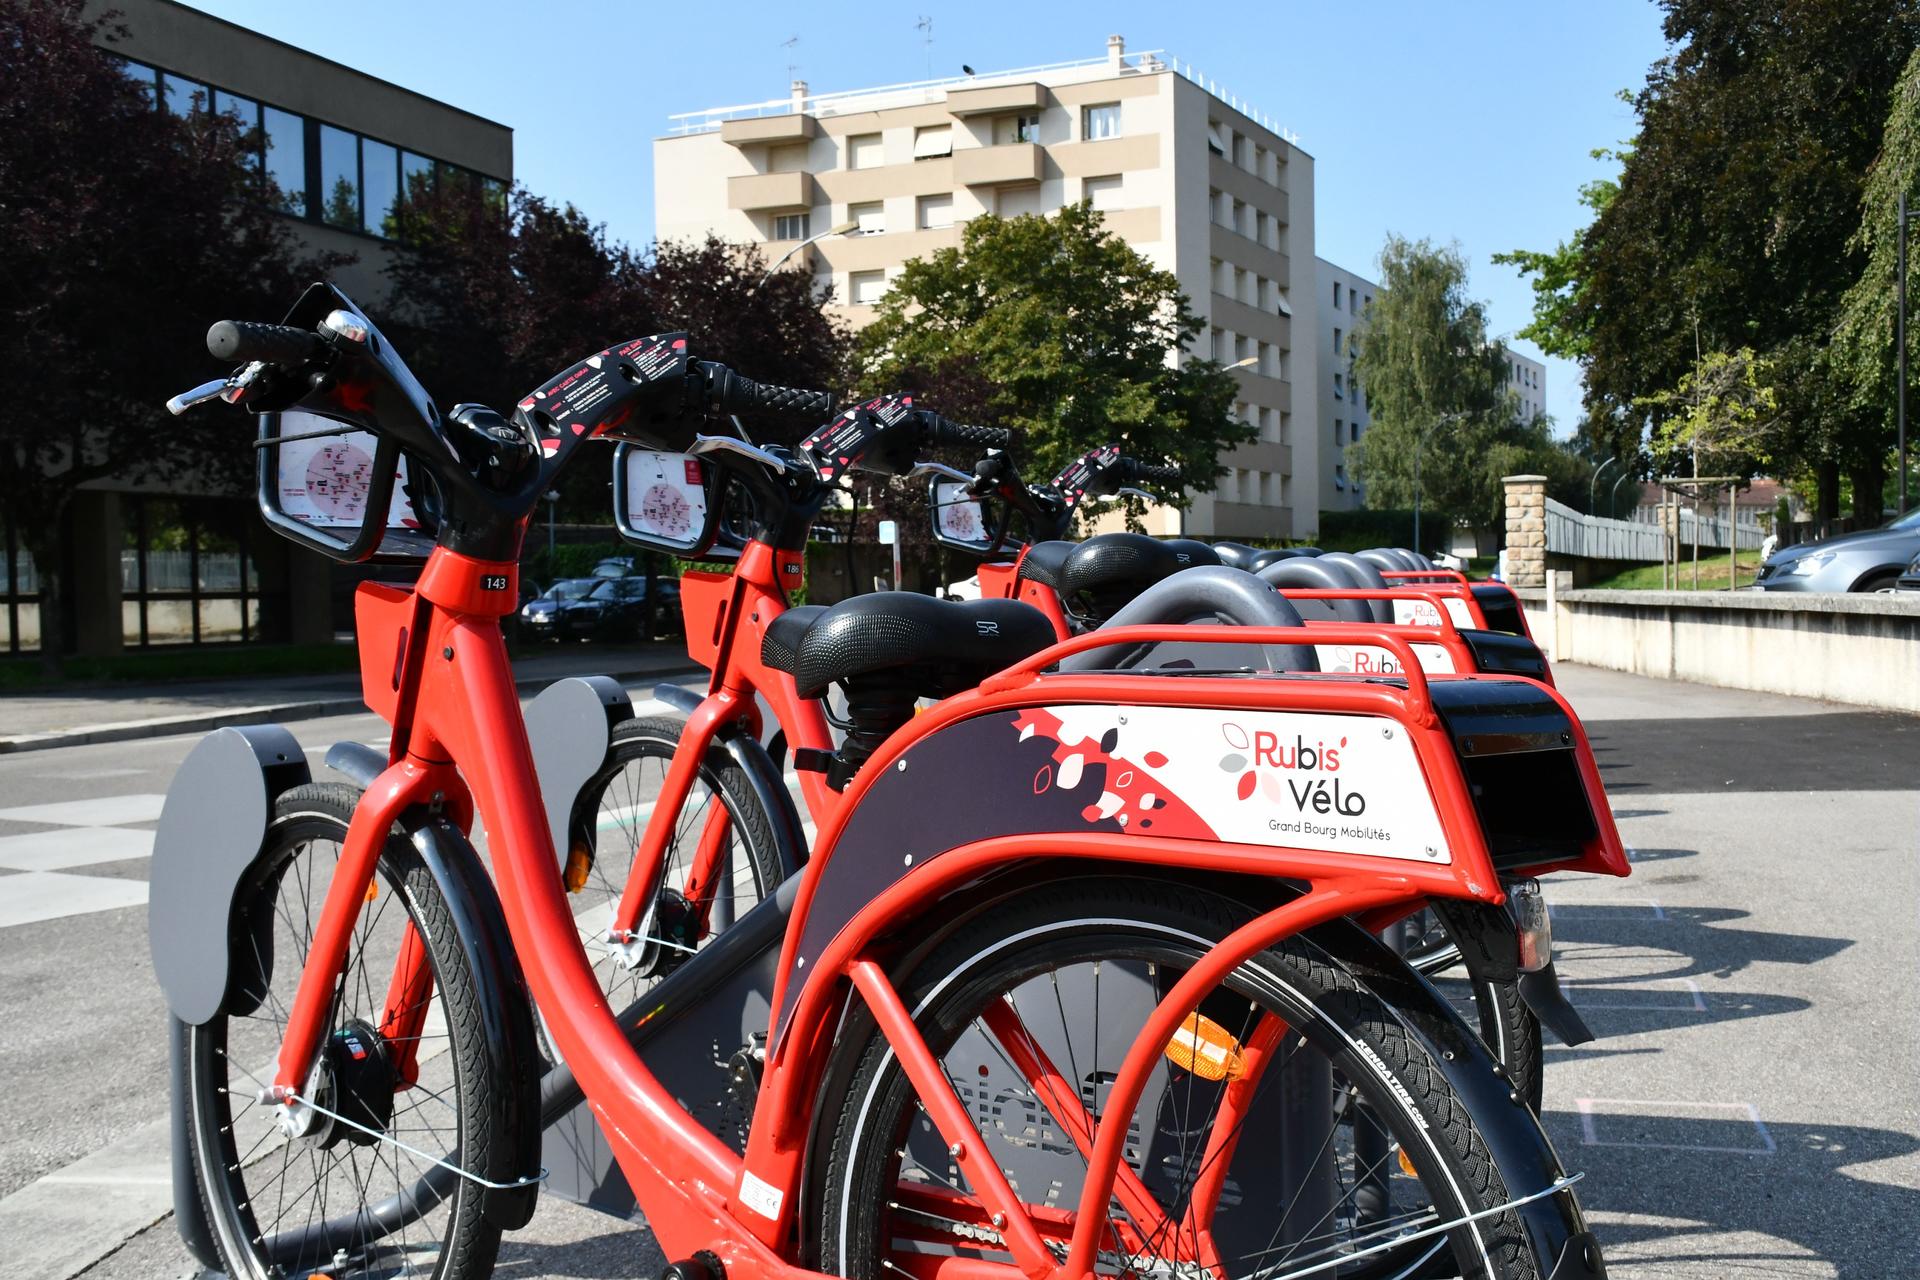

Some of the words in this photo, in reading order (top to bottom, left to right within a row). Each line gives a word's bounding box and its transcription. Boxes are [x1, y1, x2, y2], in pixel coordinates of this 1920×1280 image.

[787, 564, 800, 574] 186
[487, 577, 506, 590] 143
[1288, 778, 1366, 816] Vélo
[1269, 819, 1301, 833] Grand
[1304, 822, 1337, 840] Bourg
[1340, 828, 1391, 841] Mobilités
